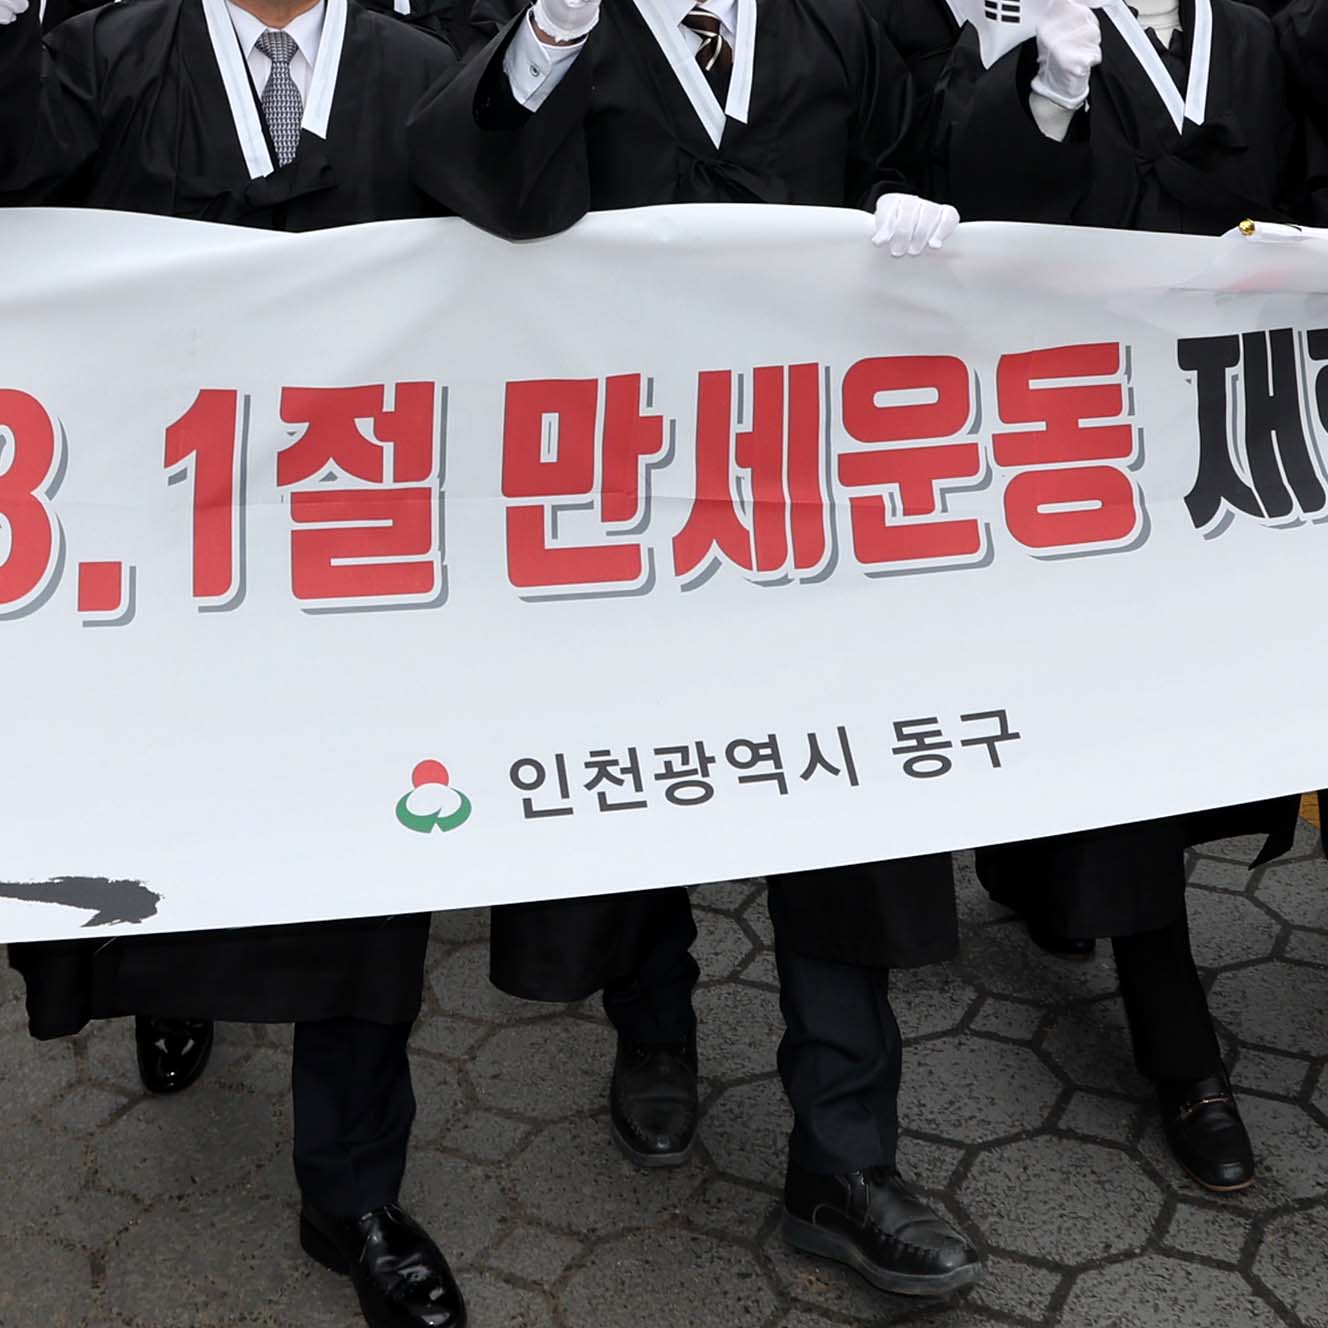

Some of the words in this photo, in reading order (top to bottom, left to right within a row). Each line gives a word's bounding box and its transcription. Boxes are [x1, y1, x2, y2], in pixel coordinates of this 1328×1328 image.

[499, 340, 1142, 594] 만세운동
[509, 725, 861, 820] 인천광역시
[891, 708, 1022, 780] 동구
